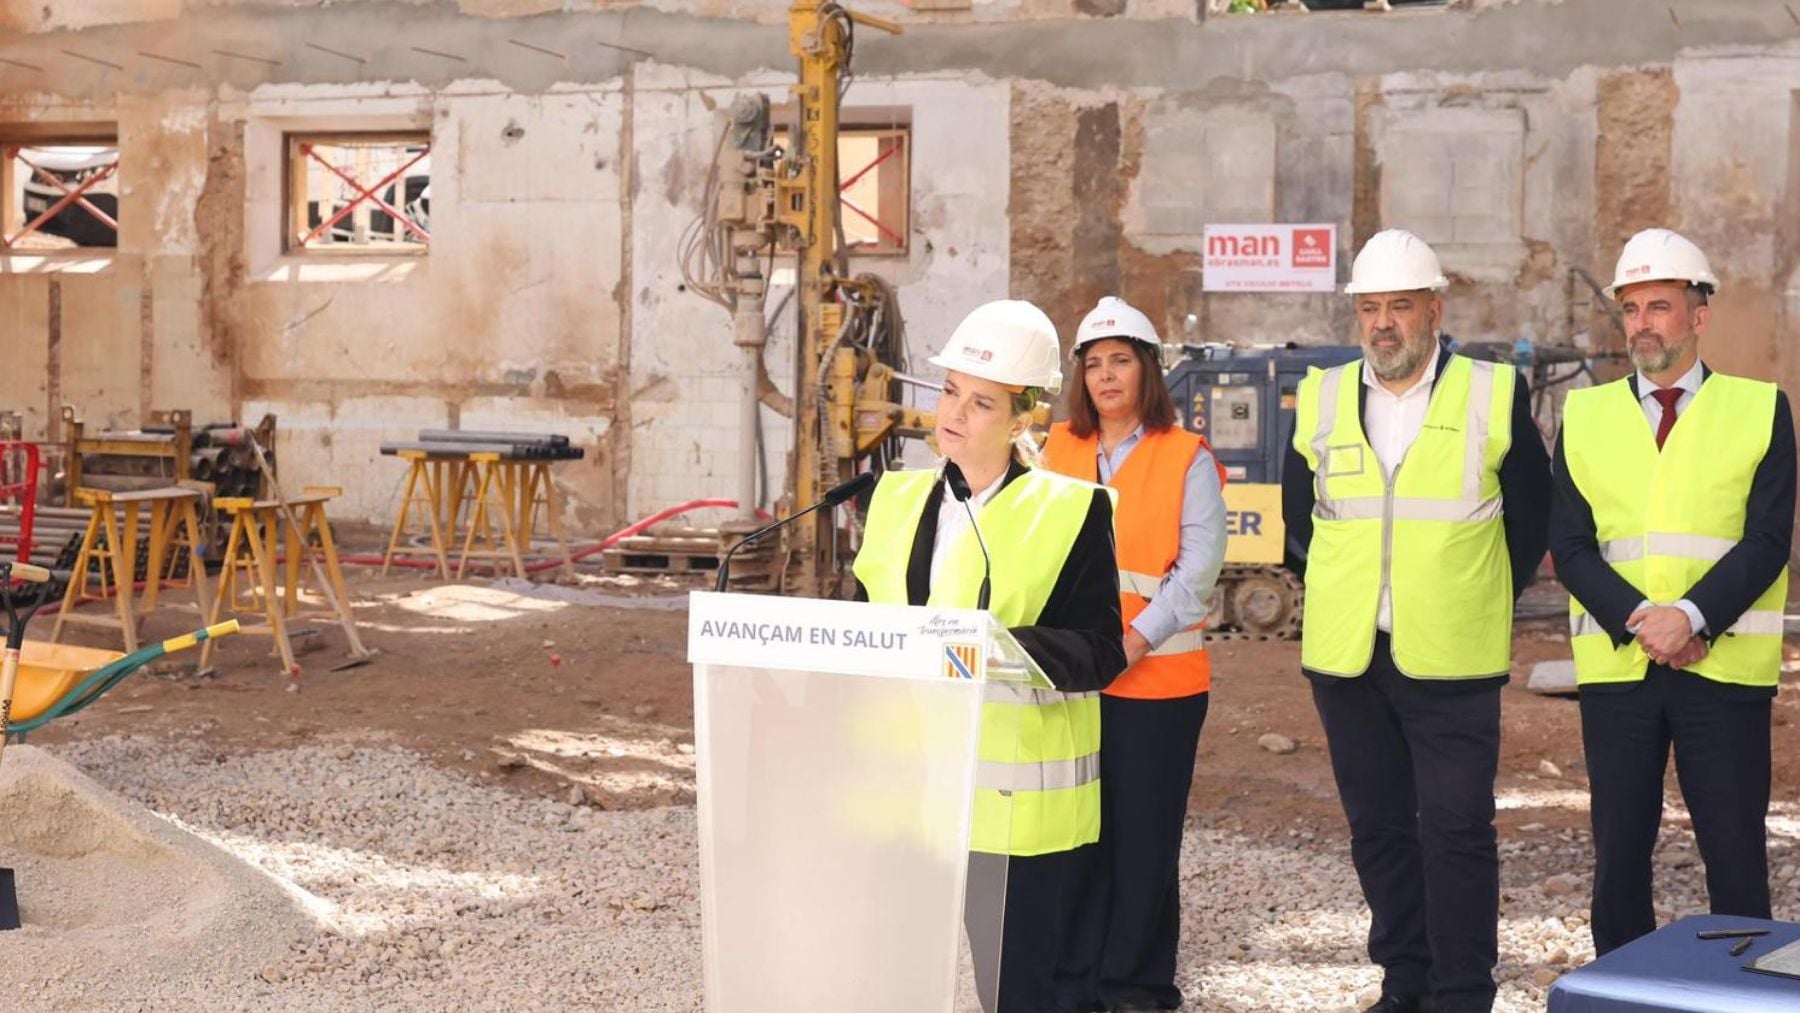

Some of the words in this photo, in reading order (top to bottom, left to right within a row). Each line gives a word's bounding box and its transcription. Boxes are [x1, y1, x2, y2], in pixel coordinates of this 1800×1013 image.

[1208, 235, 1280, 256] man
[700, 620, 802, 645] AVANÇAM
[809, 627, 836, 645] EN
[842, 630, 908, 650] SALUT
